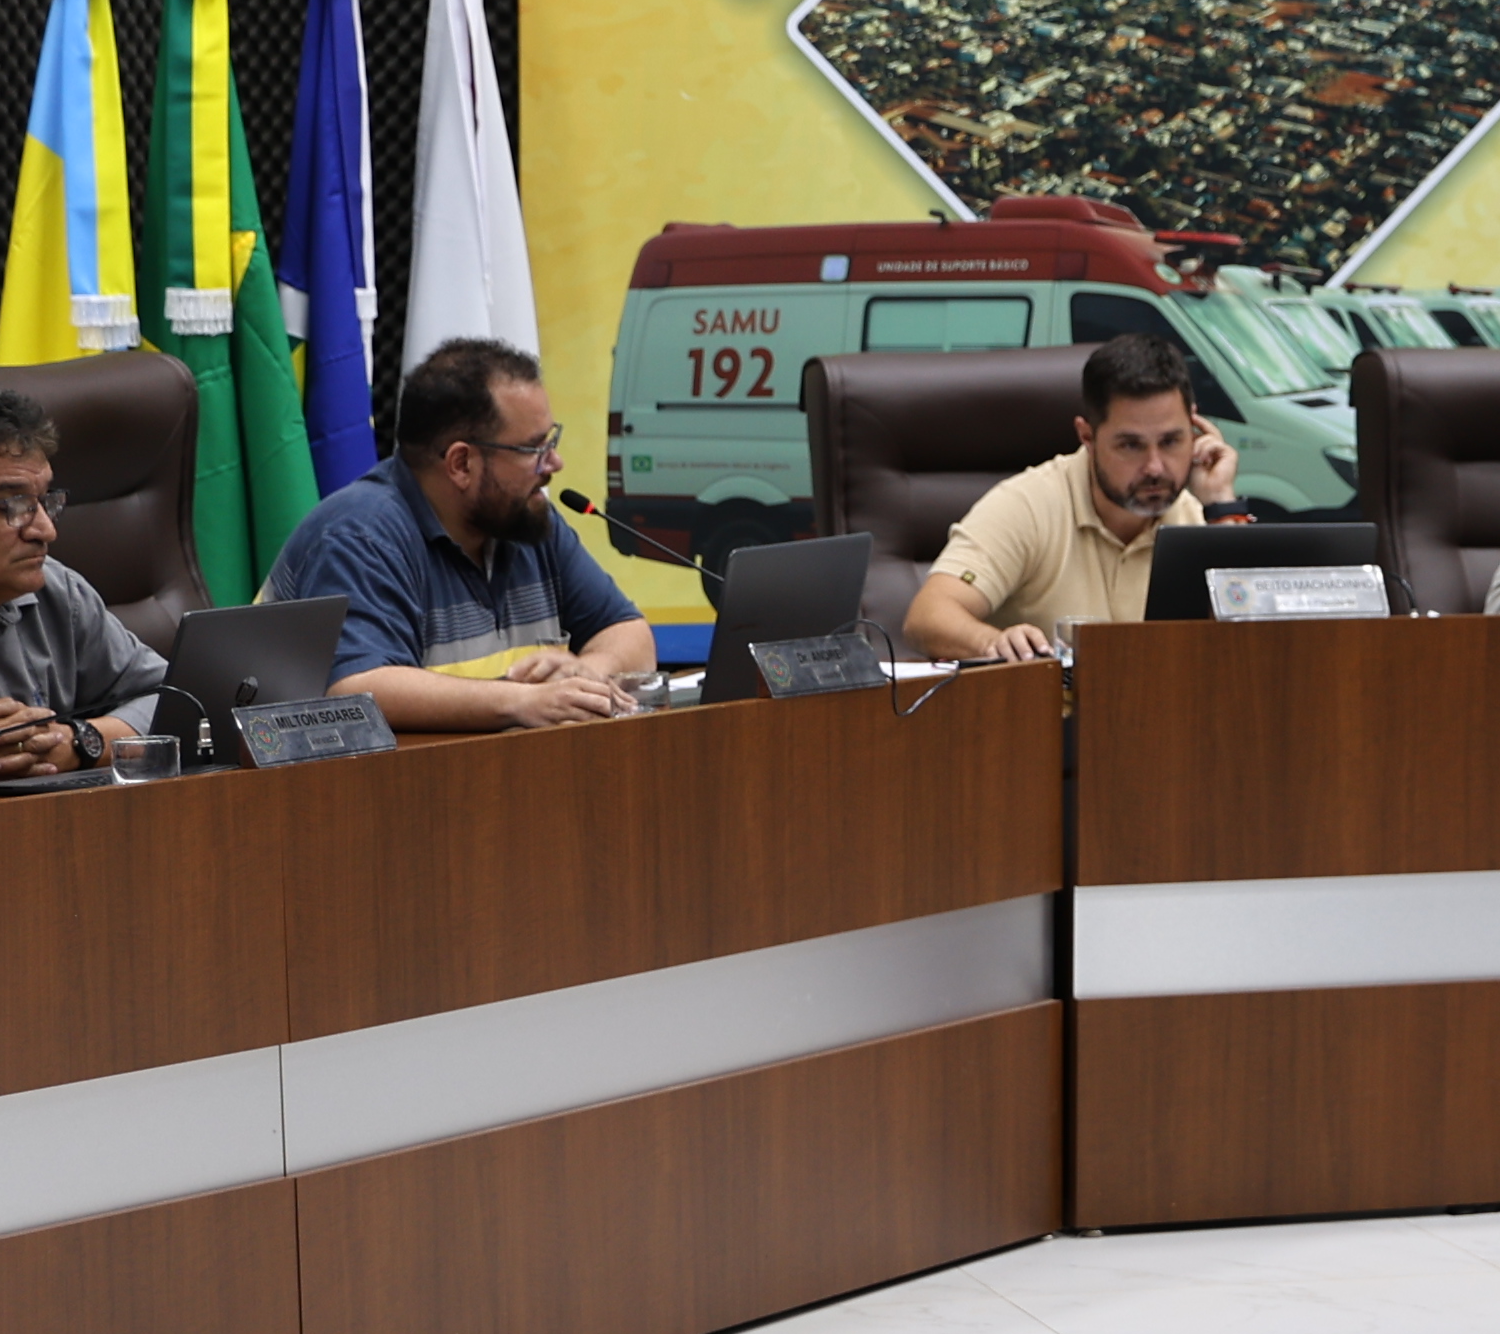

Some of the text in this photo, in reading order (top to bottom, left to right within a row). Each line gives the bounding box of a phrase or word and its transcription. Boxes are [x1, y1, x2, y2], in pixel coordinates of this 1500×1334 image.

[876, 259, 922, 273] UNIDADE
[924, 259, 938, 273] DE
[940, 258, 987, 272] SUPORTE
[692, 308, 780, 336] SAMU
[687, 346, 776, 399] 192
[275, 707, 366, 730] MILTON SOARES
